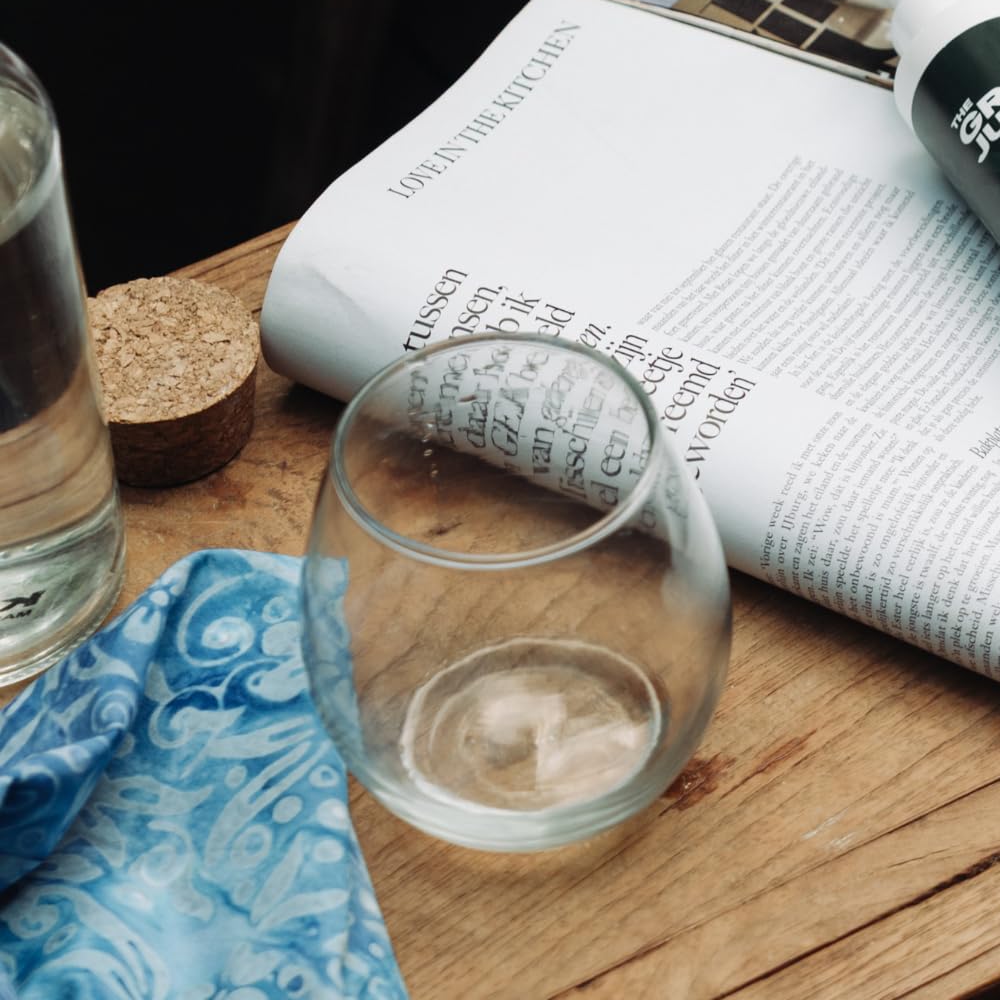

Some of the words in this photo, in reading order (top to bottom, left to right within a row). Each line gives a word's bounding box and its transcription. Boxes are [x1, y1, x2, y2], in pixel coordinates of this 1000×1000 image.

[388, 154, 447, 204] LOVE
[433, 137, 468, 168] IN
[453, 103, 506, 150] THE
[493, 14, 581, 115] KITCHEN
[950, 98, 974, 130] THE
[501, 287, 540, 317] ik
